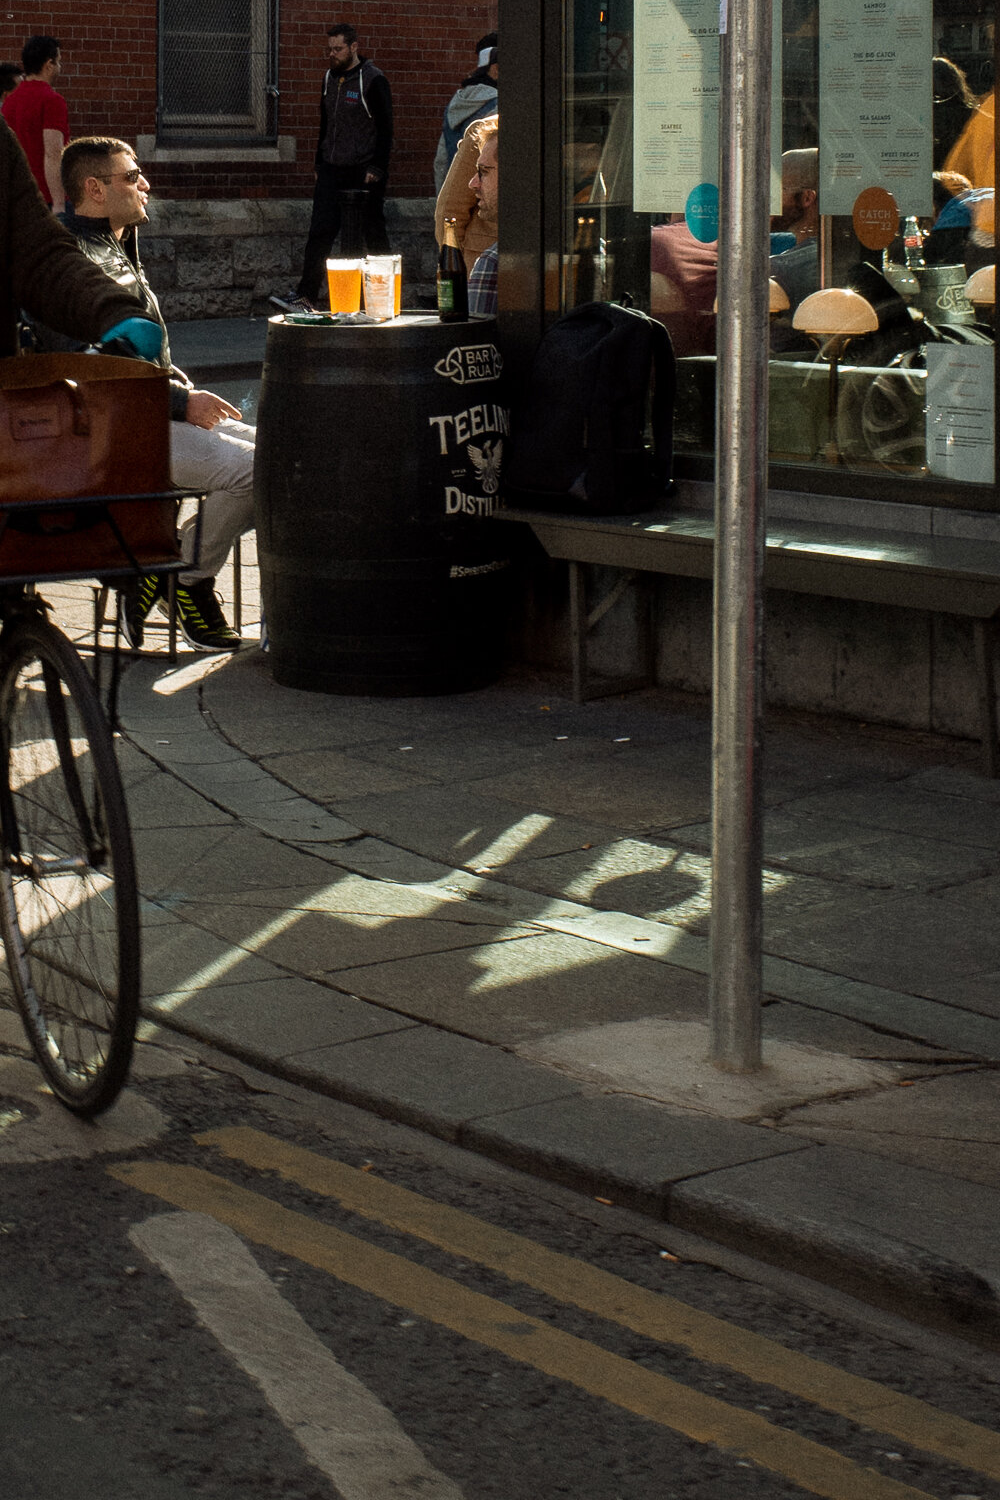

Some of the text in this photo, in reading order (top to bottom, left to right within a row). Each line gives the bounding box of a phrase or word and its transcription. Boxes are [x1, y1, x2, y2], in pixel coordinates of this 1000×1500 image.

[859, 209, 891, 219] CATCH
[465, 349, 490, 365] BAR
[468, 364, 493, 379] RUA
[428, 403, 512, 456] TEELIN
